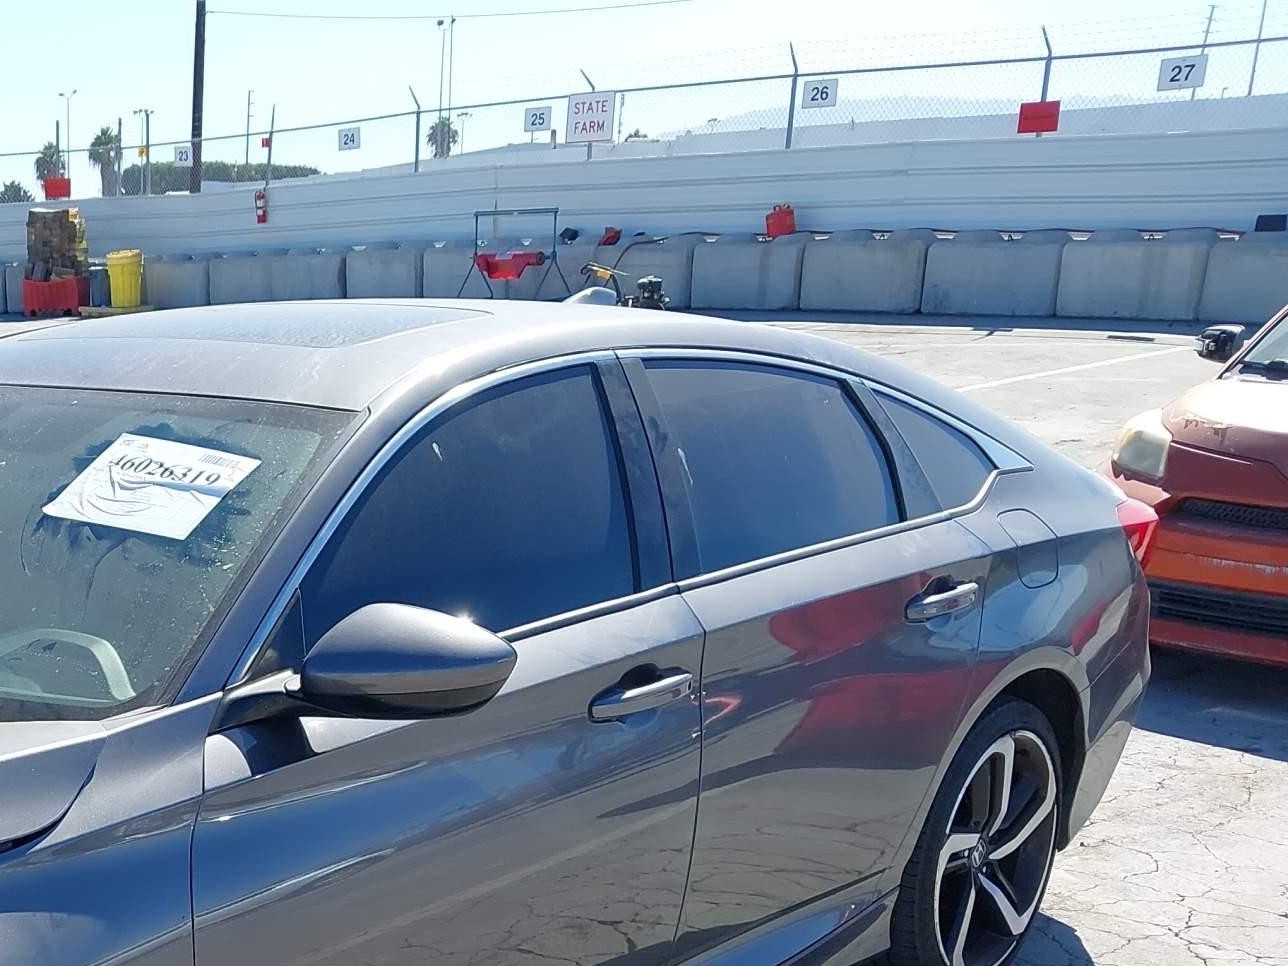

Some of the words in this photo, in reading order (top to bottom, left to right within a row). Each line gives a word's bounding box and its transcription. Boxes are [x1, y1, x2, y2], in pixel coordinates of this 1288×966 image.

[1168, 63, 1196, 83] 27
[810, 85, 829, 102] 26
[574, 99, 609, 115] STATE
[530, 112, 545, 126] 25
[574, 119, 605, 135] FARM
[343, 132, 355, 146] 24
[178, 150, 189, 162] 23
